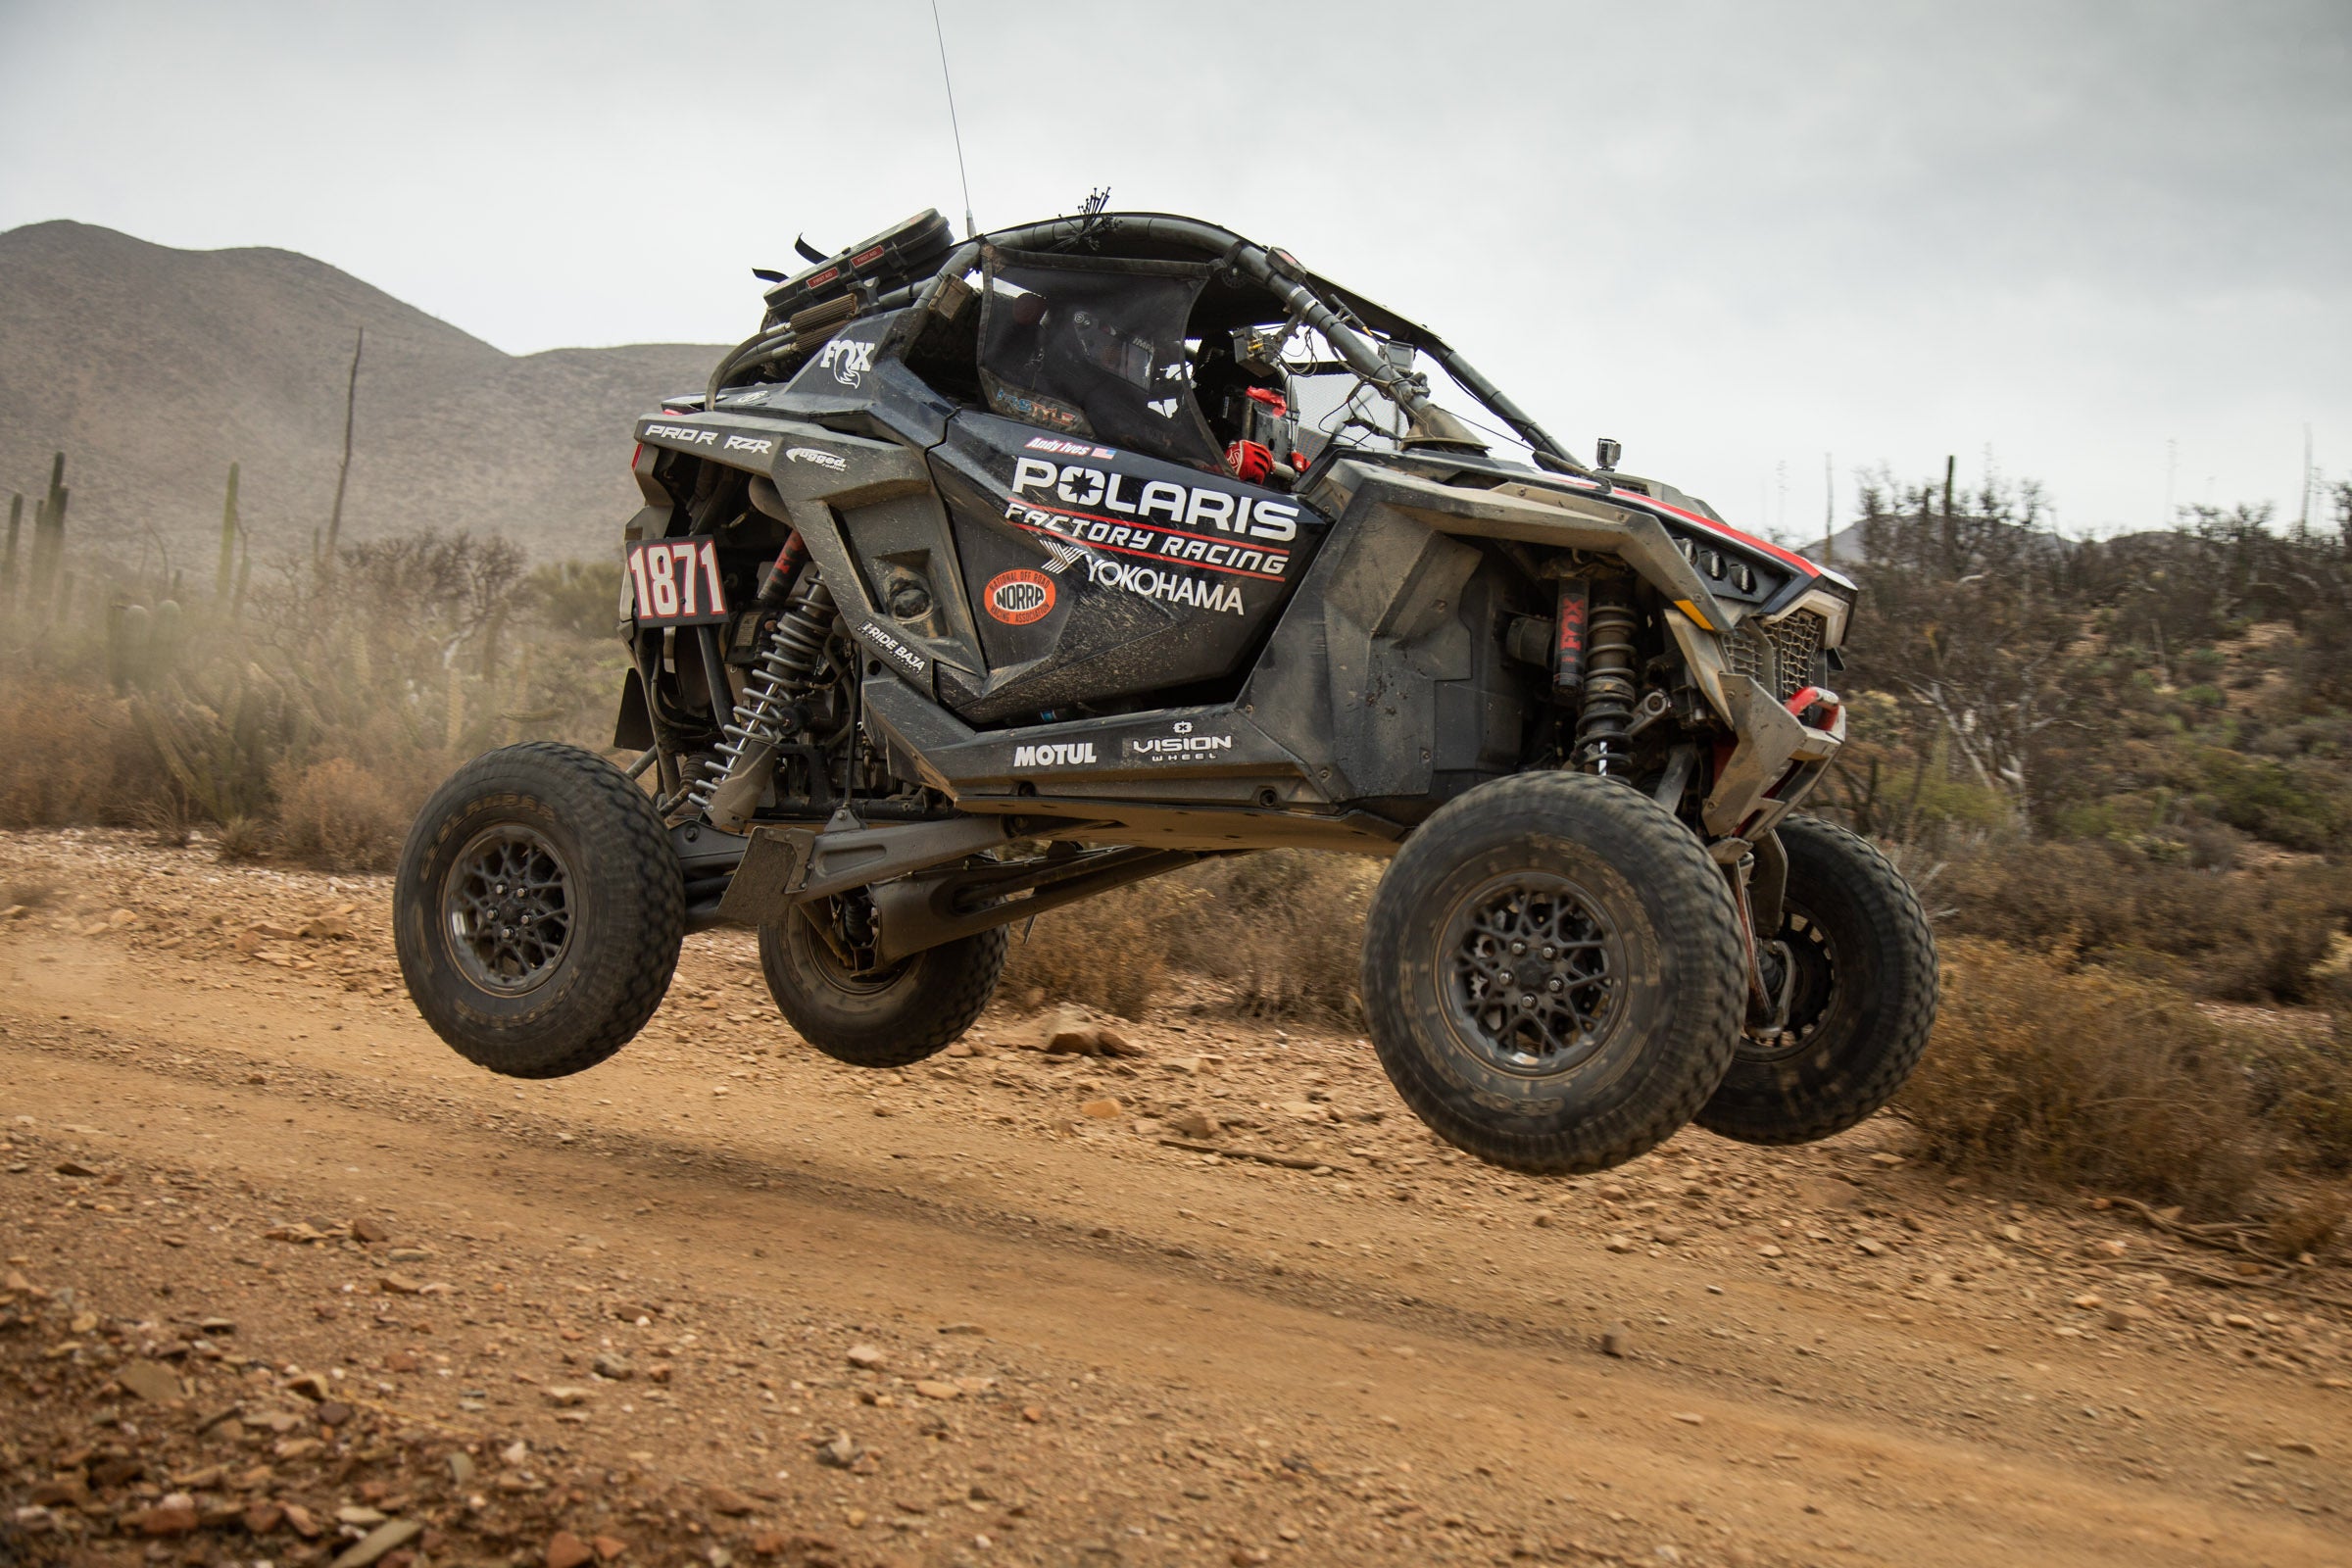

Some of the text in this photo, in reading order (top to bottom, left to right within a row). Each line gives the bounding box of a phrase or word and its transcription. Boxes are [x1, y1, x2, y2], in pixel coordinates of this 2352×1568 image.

[820, 339, 876, 389] FOX
[645, 424, 772, 455] PRO R RZR
[1024, 436, 1092, 457] Andy Ives
[1011, 456, 1300, 542] POLARIS
[1004, 502, 1290, 574] FACTORY RACING
[628, 539, 727, 620] 1871
[989, 571, 1051, 590] NATIONAL OFF ROAD
[1085, 555, 1245, 616] YOKOHAMA
[996, 583, 1045, 611] NORRA
[868, 626, 899, 650] RIDE
[894, 646, 926, 671] BAJA
[1013, 742, 1098, 767] MOTUL
[1133, 735, 1233, 755] VISION
[1152, 752, 1217, 762] WHEEL
